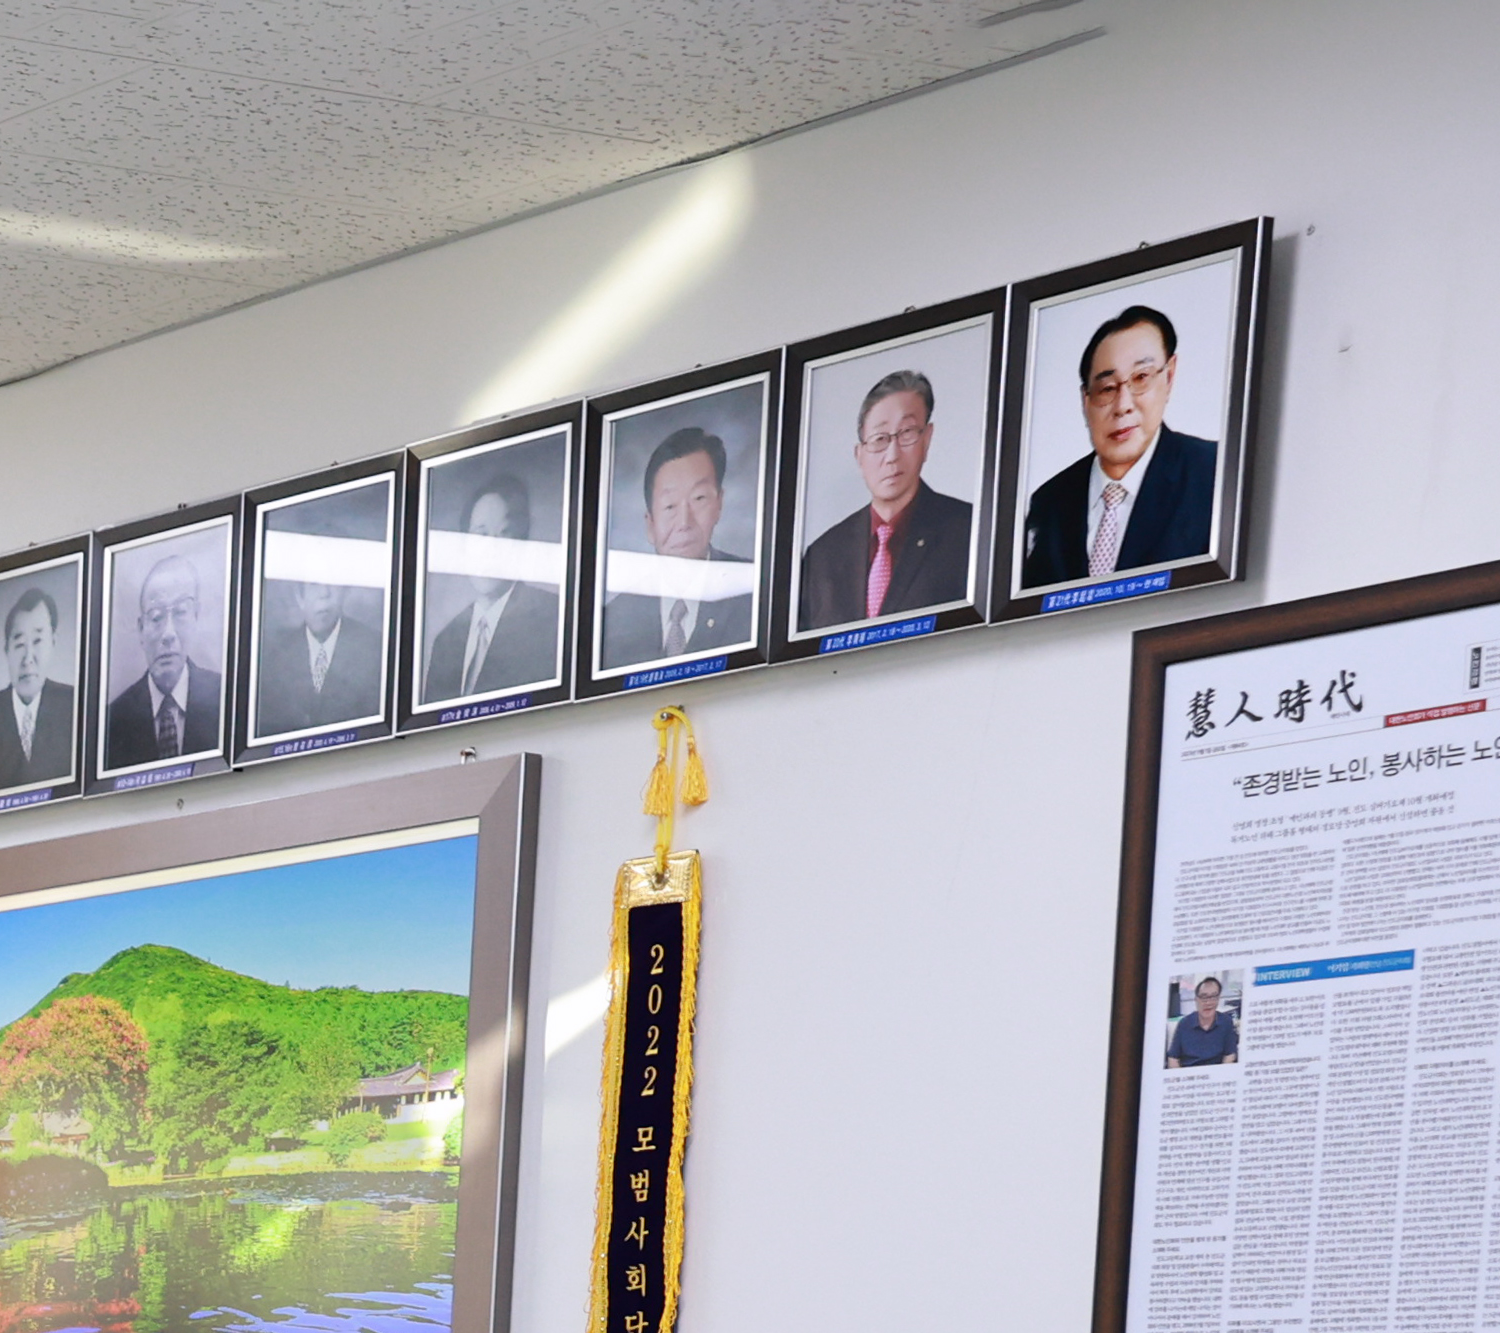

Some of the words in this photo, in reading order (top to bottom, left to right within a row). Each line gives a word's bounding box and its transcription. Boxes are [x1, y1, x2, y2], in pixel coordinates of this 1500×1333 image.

[1381, 743, 1466, 778] 봉사하는
[1256, 967, 1311, 982] INTERVIEW
[640, 943, 666, 1098] 2022
